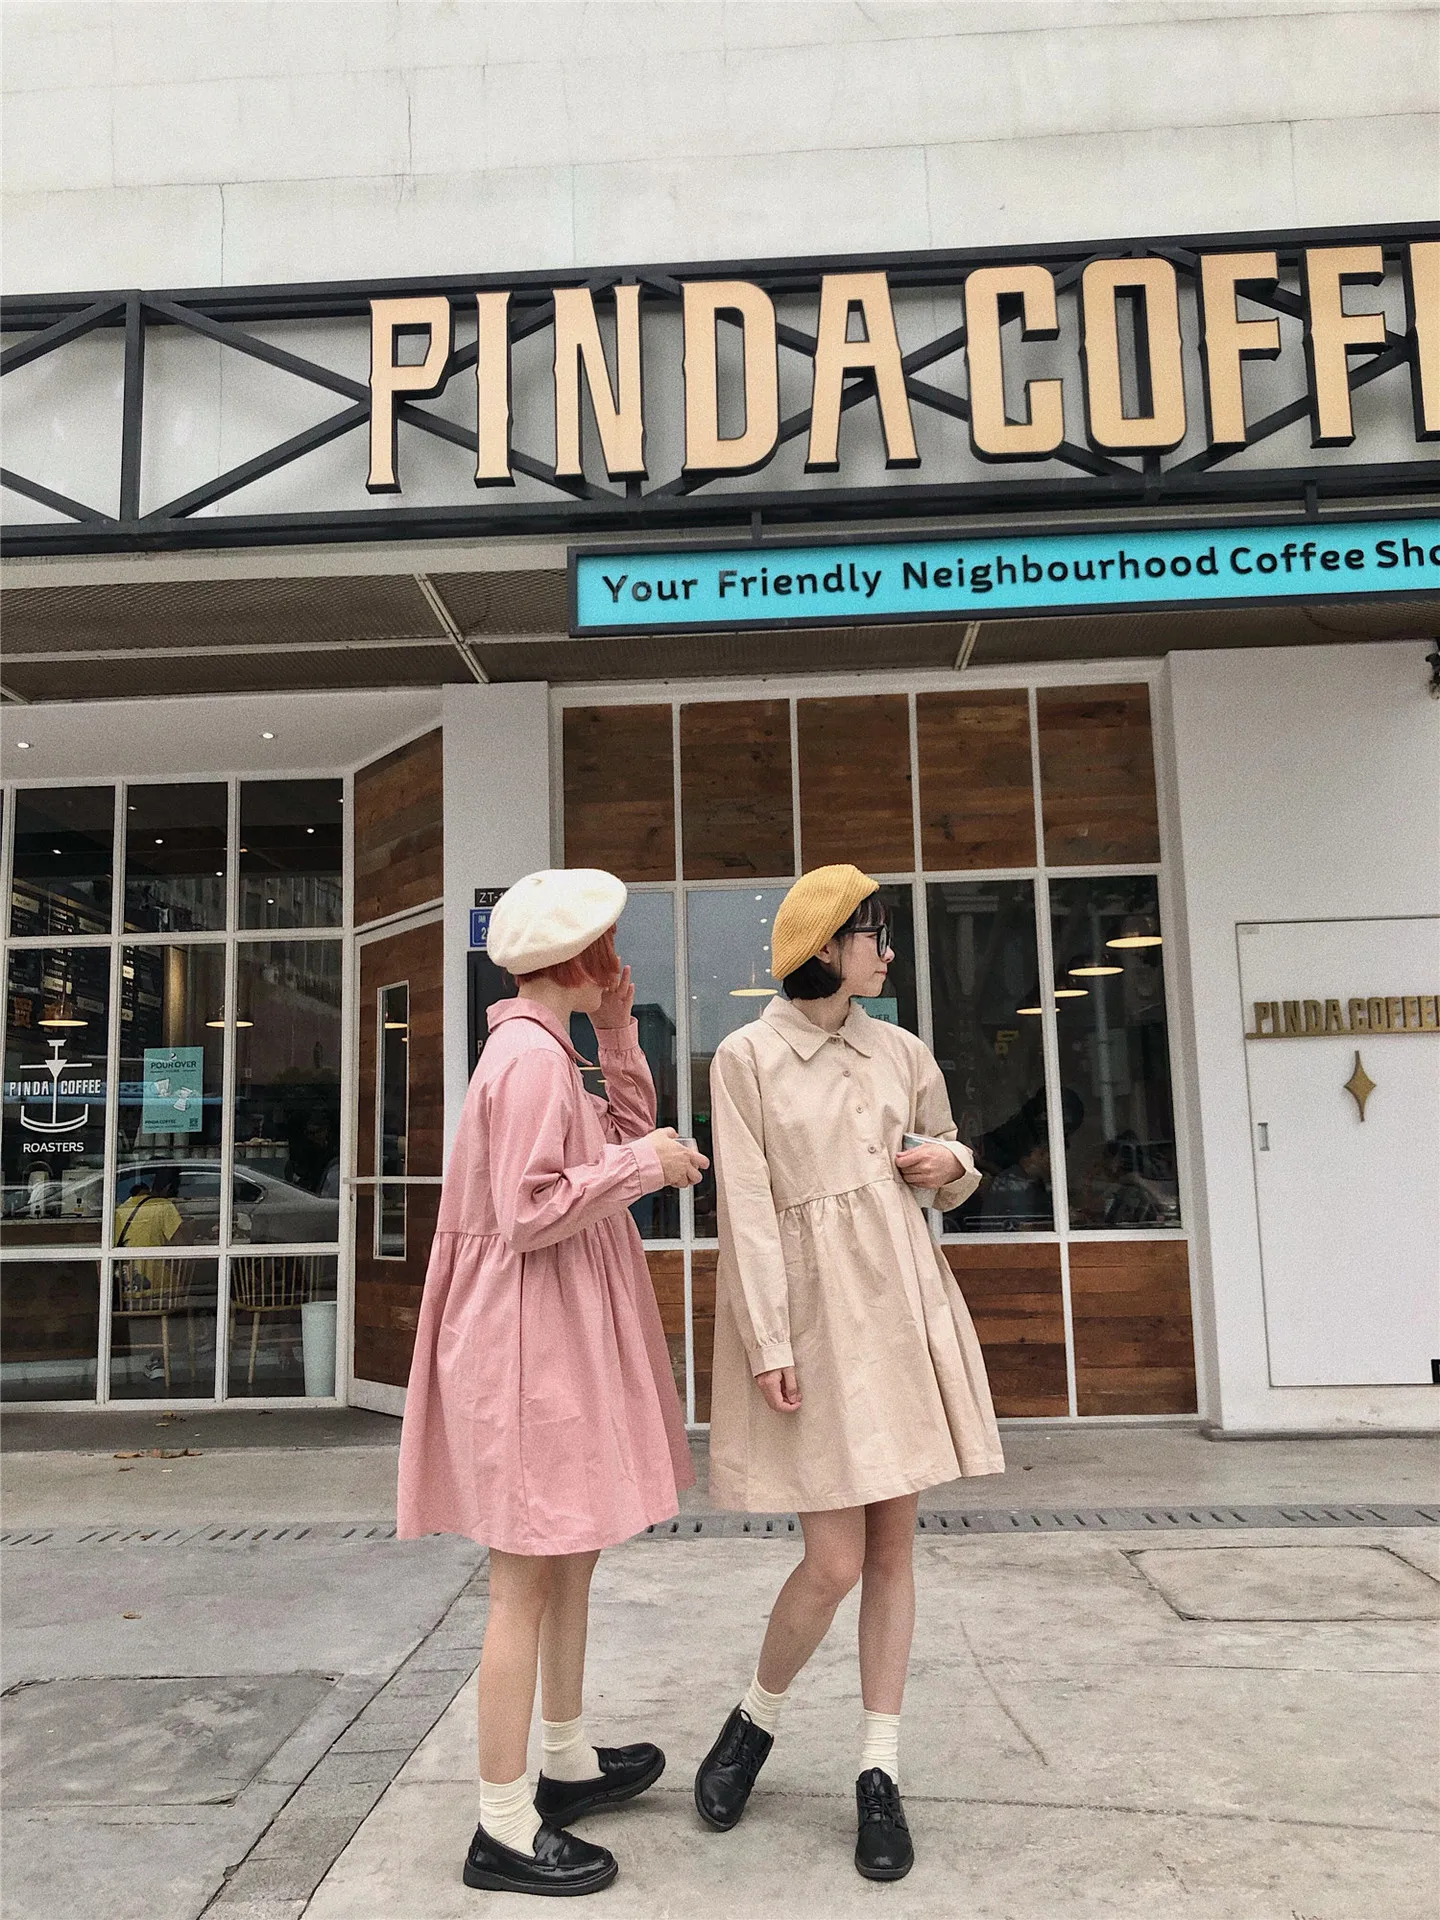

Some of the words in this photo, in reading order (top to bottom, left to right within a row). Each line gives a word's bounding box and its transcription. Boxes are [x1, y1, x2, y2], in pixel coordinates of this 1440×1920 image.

[366, 270, 921, 494] PINDA
[602, 575, 699, 604] Your
[718, 562, 882, 598] Friendly
[903, 546, 1220, 594] Neighbourhood
[1230, 542, 1366, 576] Coffee
[1253, 999, 1344, 1033] PINDA
[1348, 995, 1440, 1031] COFFE
[150, 1061, 173, 1069] POUR
[174, 1060, 197, 1069] OVER
[9, 1080, 50, 1097] PINDA
[60, 1079, 102, 1095] COFFEE
[22, 1141, 85, 1154] ROASTERS
